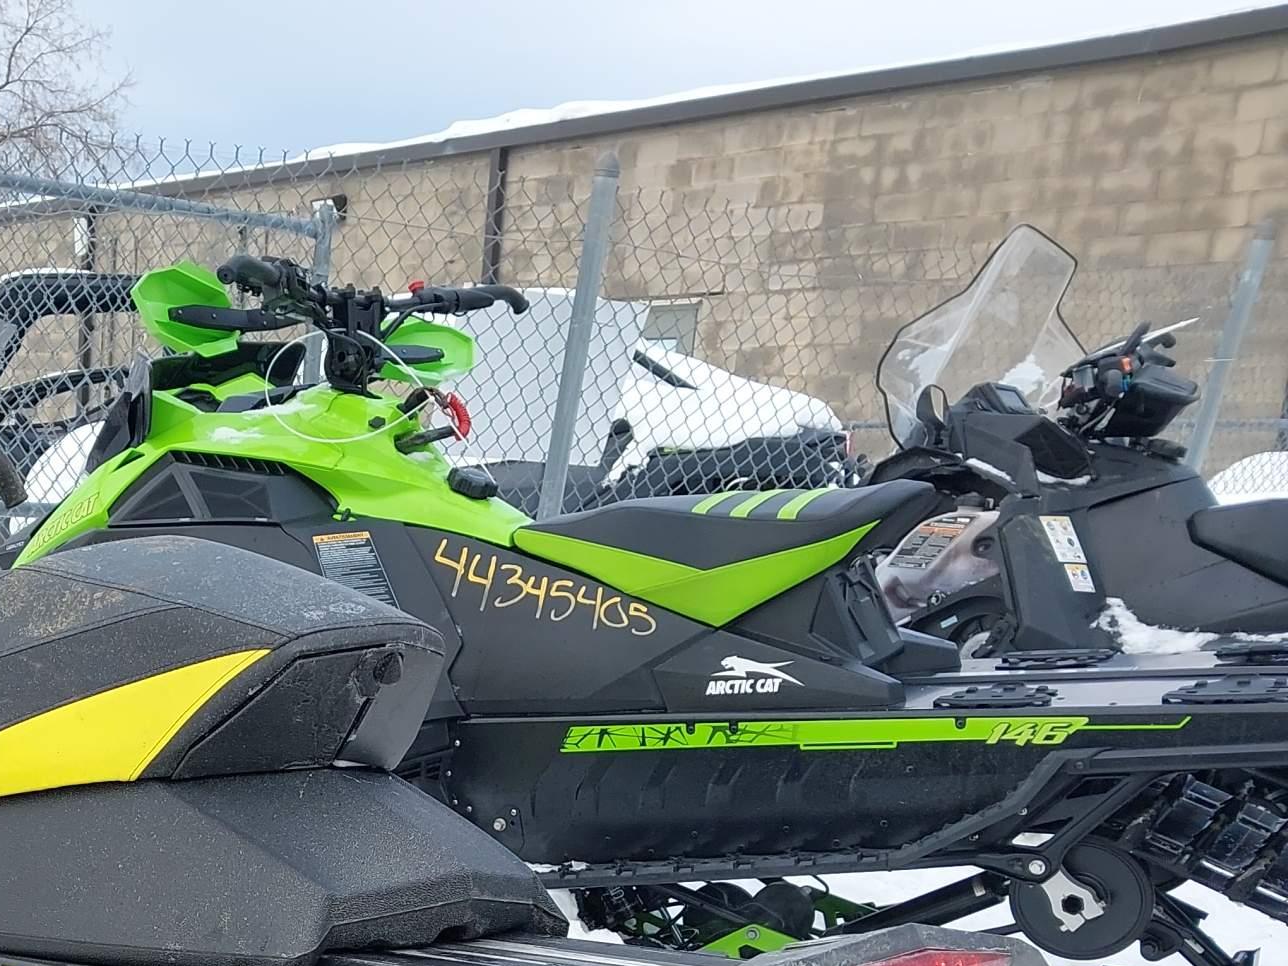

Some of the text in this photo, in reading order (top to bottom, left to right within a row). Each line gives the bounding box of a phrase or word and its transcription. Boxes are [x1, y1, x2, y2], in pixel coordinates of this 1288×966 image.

[434, 538, 656, 636] 44345405
[705, 678, 783, 695] ARCTIC CAT
[985, 722, 1072, 746] 146
